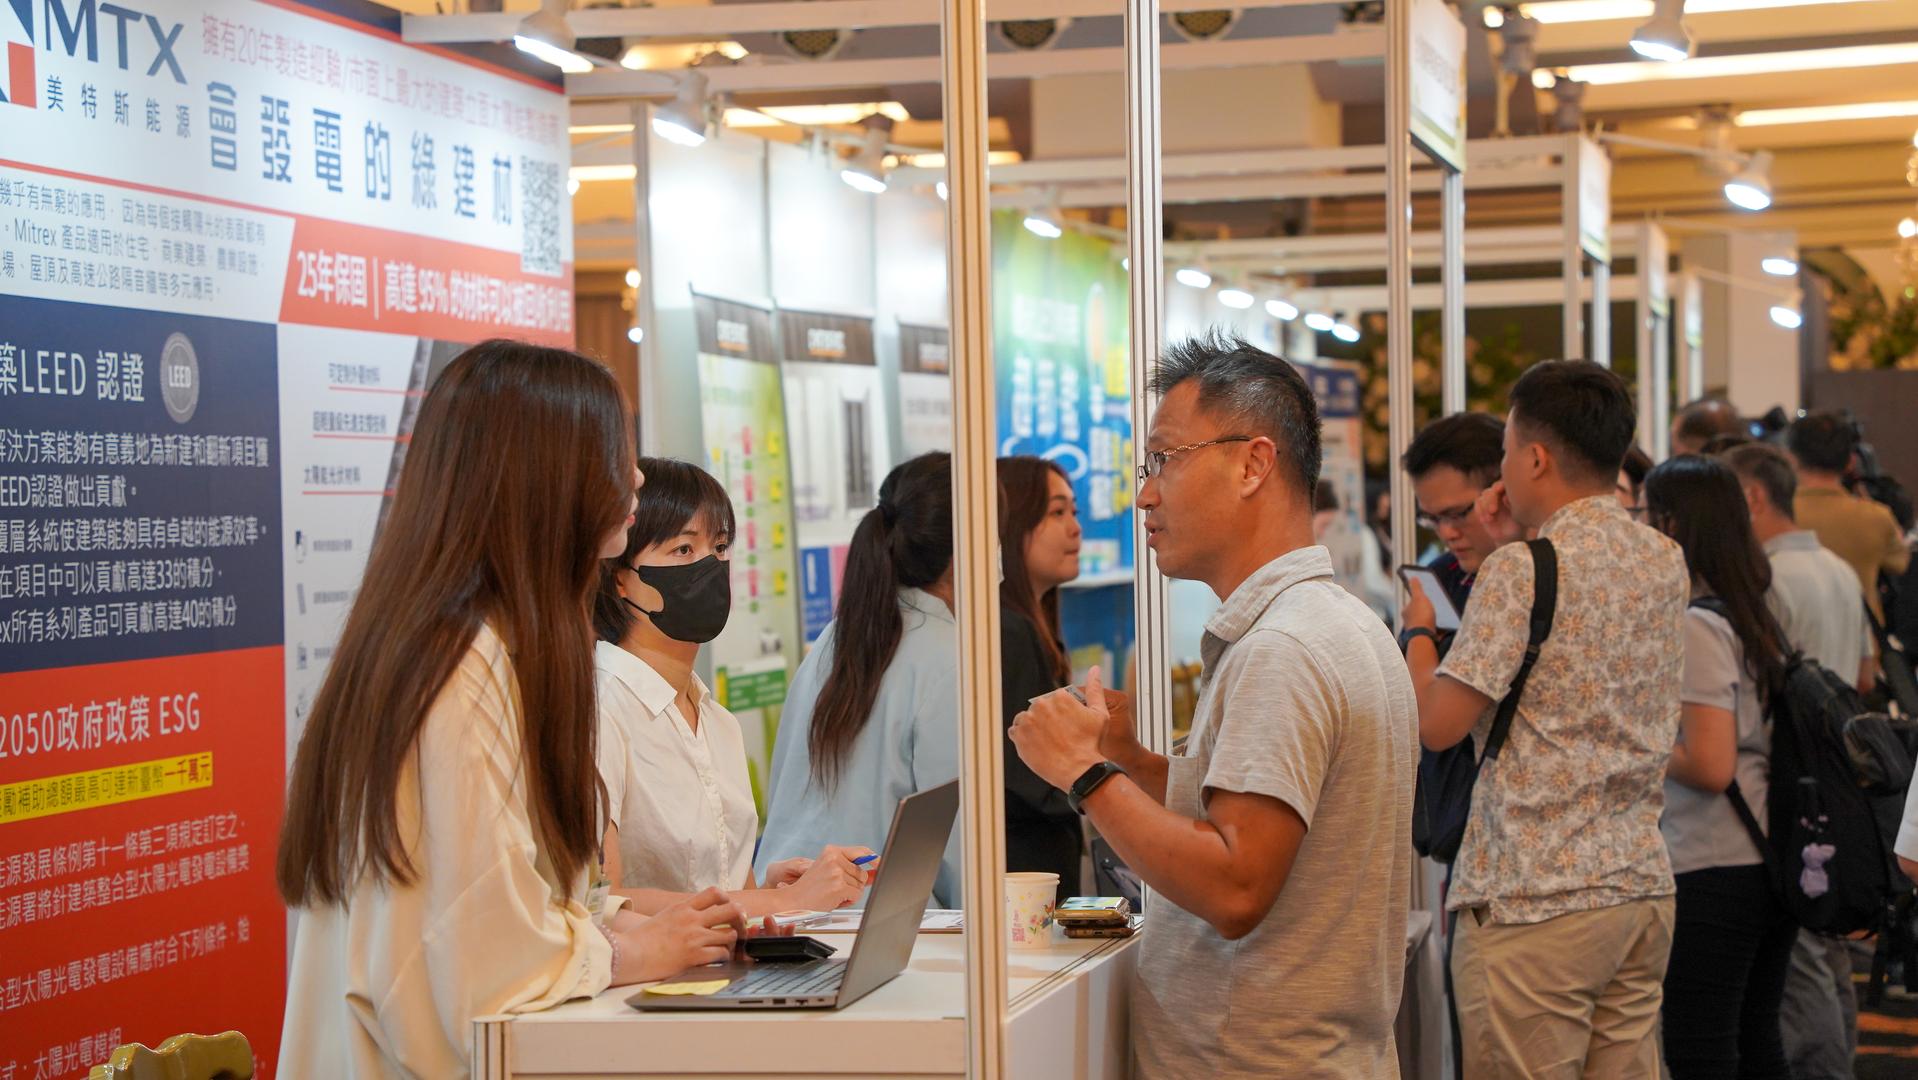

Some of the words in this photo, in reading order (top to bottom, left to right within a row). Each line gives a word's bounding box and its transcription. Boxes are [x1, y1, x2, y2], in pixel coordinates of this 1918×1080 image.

[44, 0, 188, 85] MTX
[47, 74, 191, 139] 美特斯能源
[206, 81, 512, 226] 會發電的綠建材
[96, 349, 145, 402] 認證
[168, 364, 192, 389] LEED
[0, 595, 237, 645] x所有系列產品可貢獻高達40的積分
[0, 693, 150, 758] 2050政府政策
[159, 691, 200, 735] ESG
